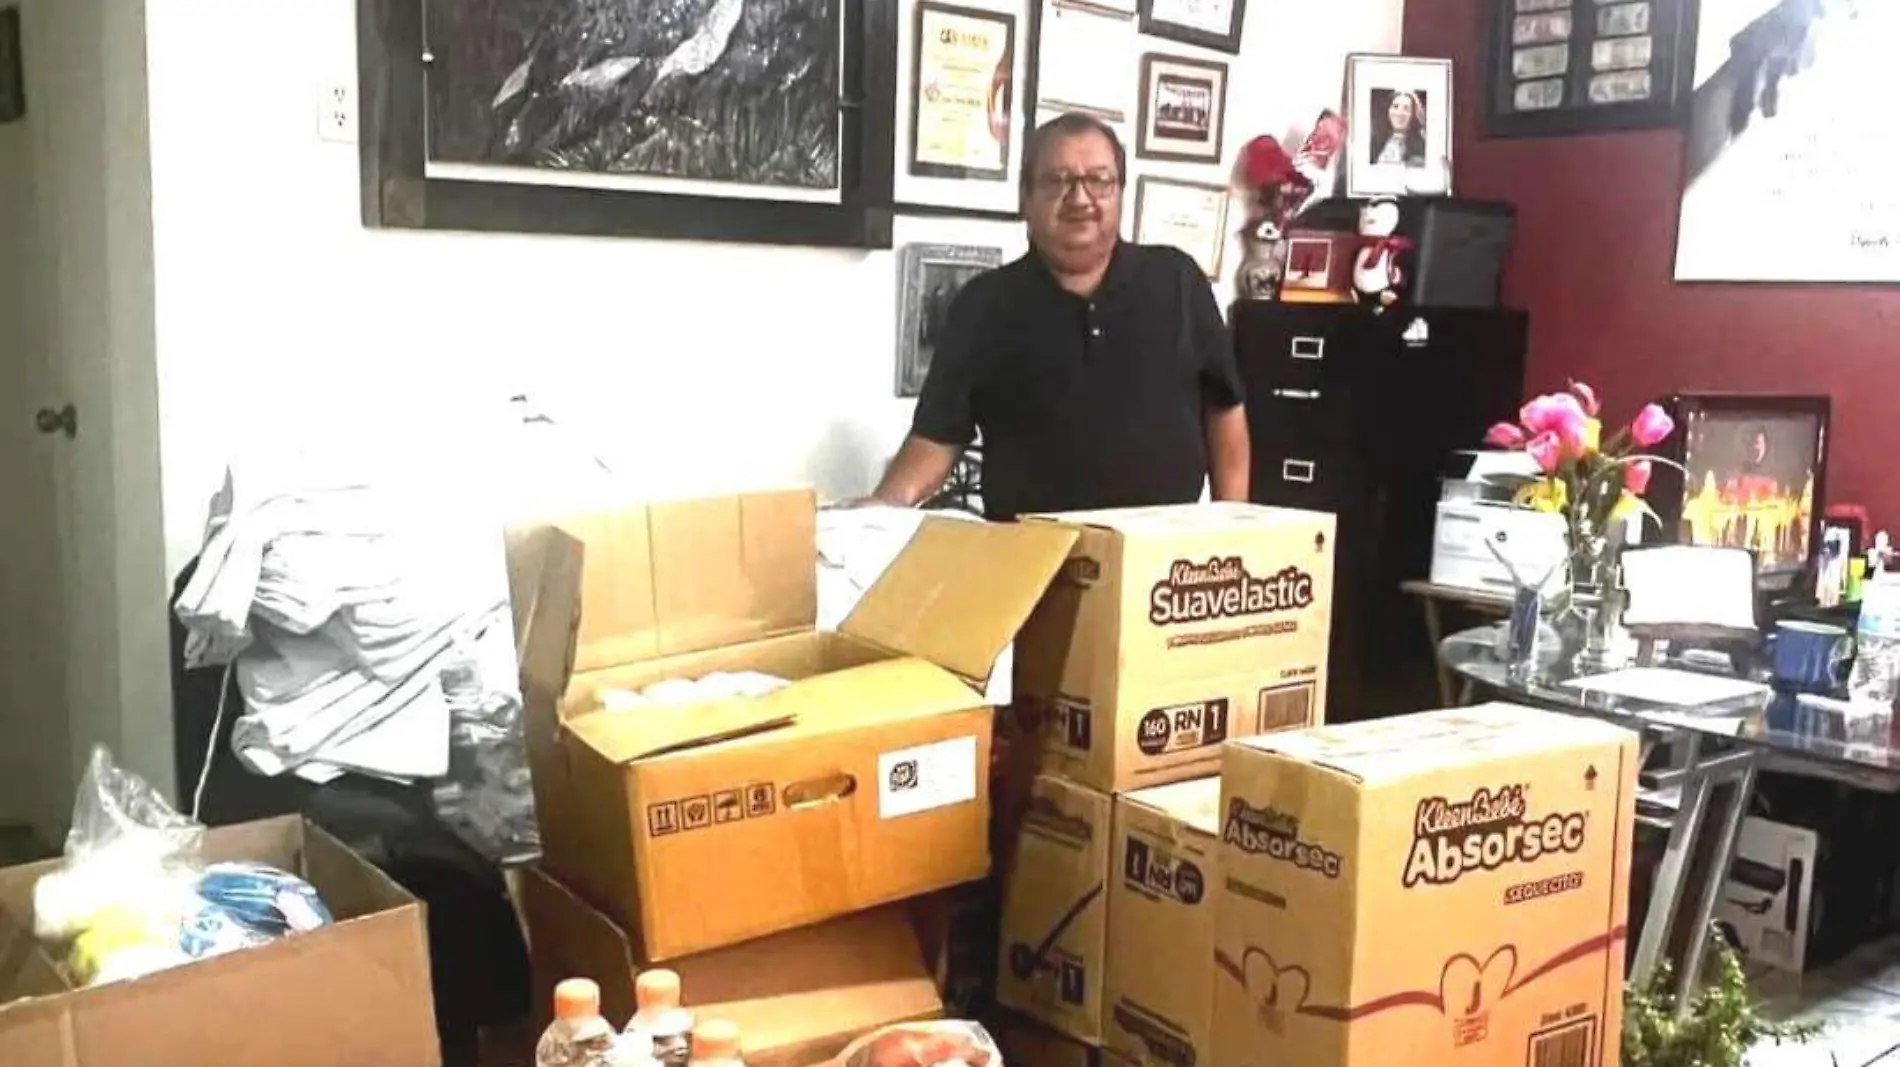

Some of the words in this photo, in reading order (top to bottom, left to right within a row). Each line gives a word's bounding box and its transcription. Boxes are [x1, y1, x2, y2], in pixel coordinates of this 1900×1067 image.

[1152, 571, 1311, 621] Suavelastic
[1174, 708, 1201, 732] RN
[1210, 704, 1220, 732] 1
[1225, 819, 1340, 876] Absorsec
[1405, 816, 1583, 882] Absorsec
